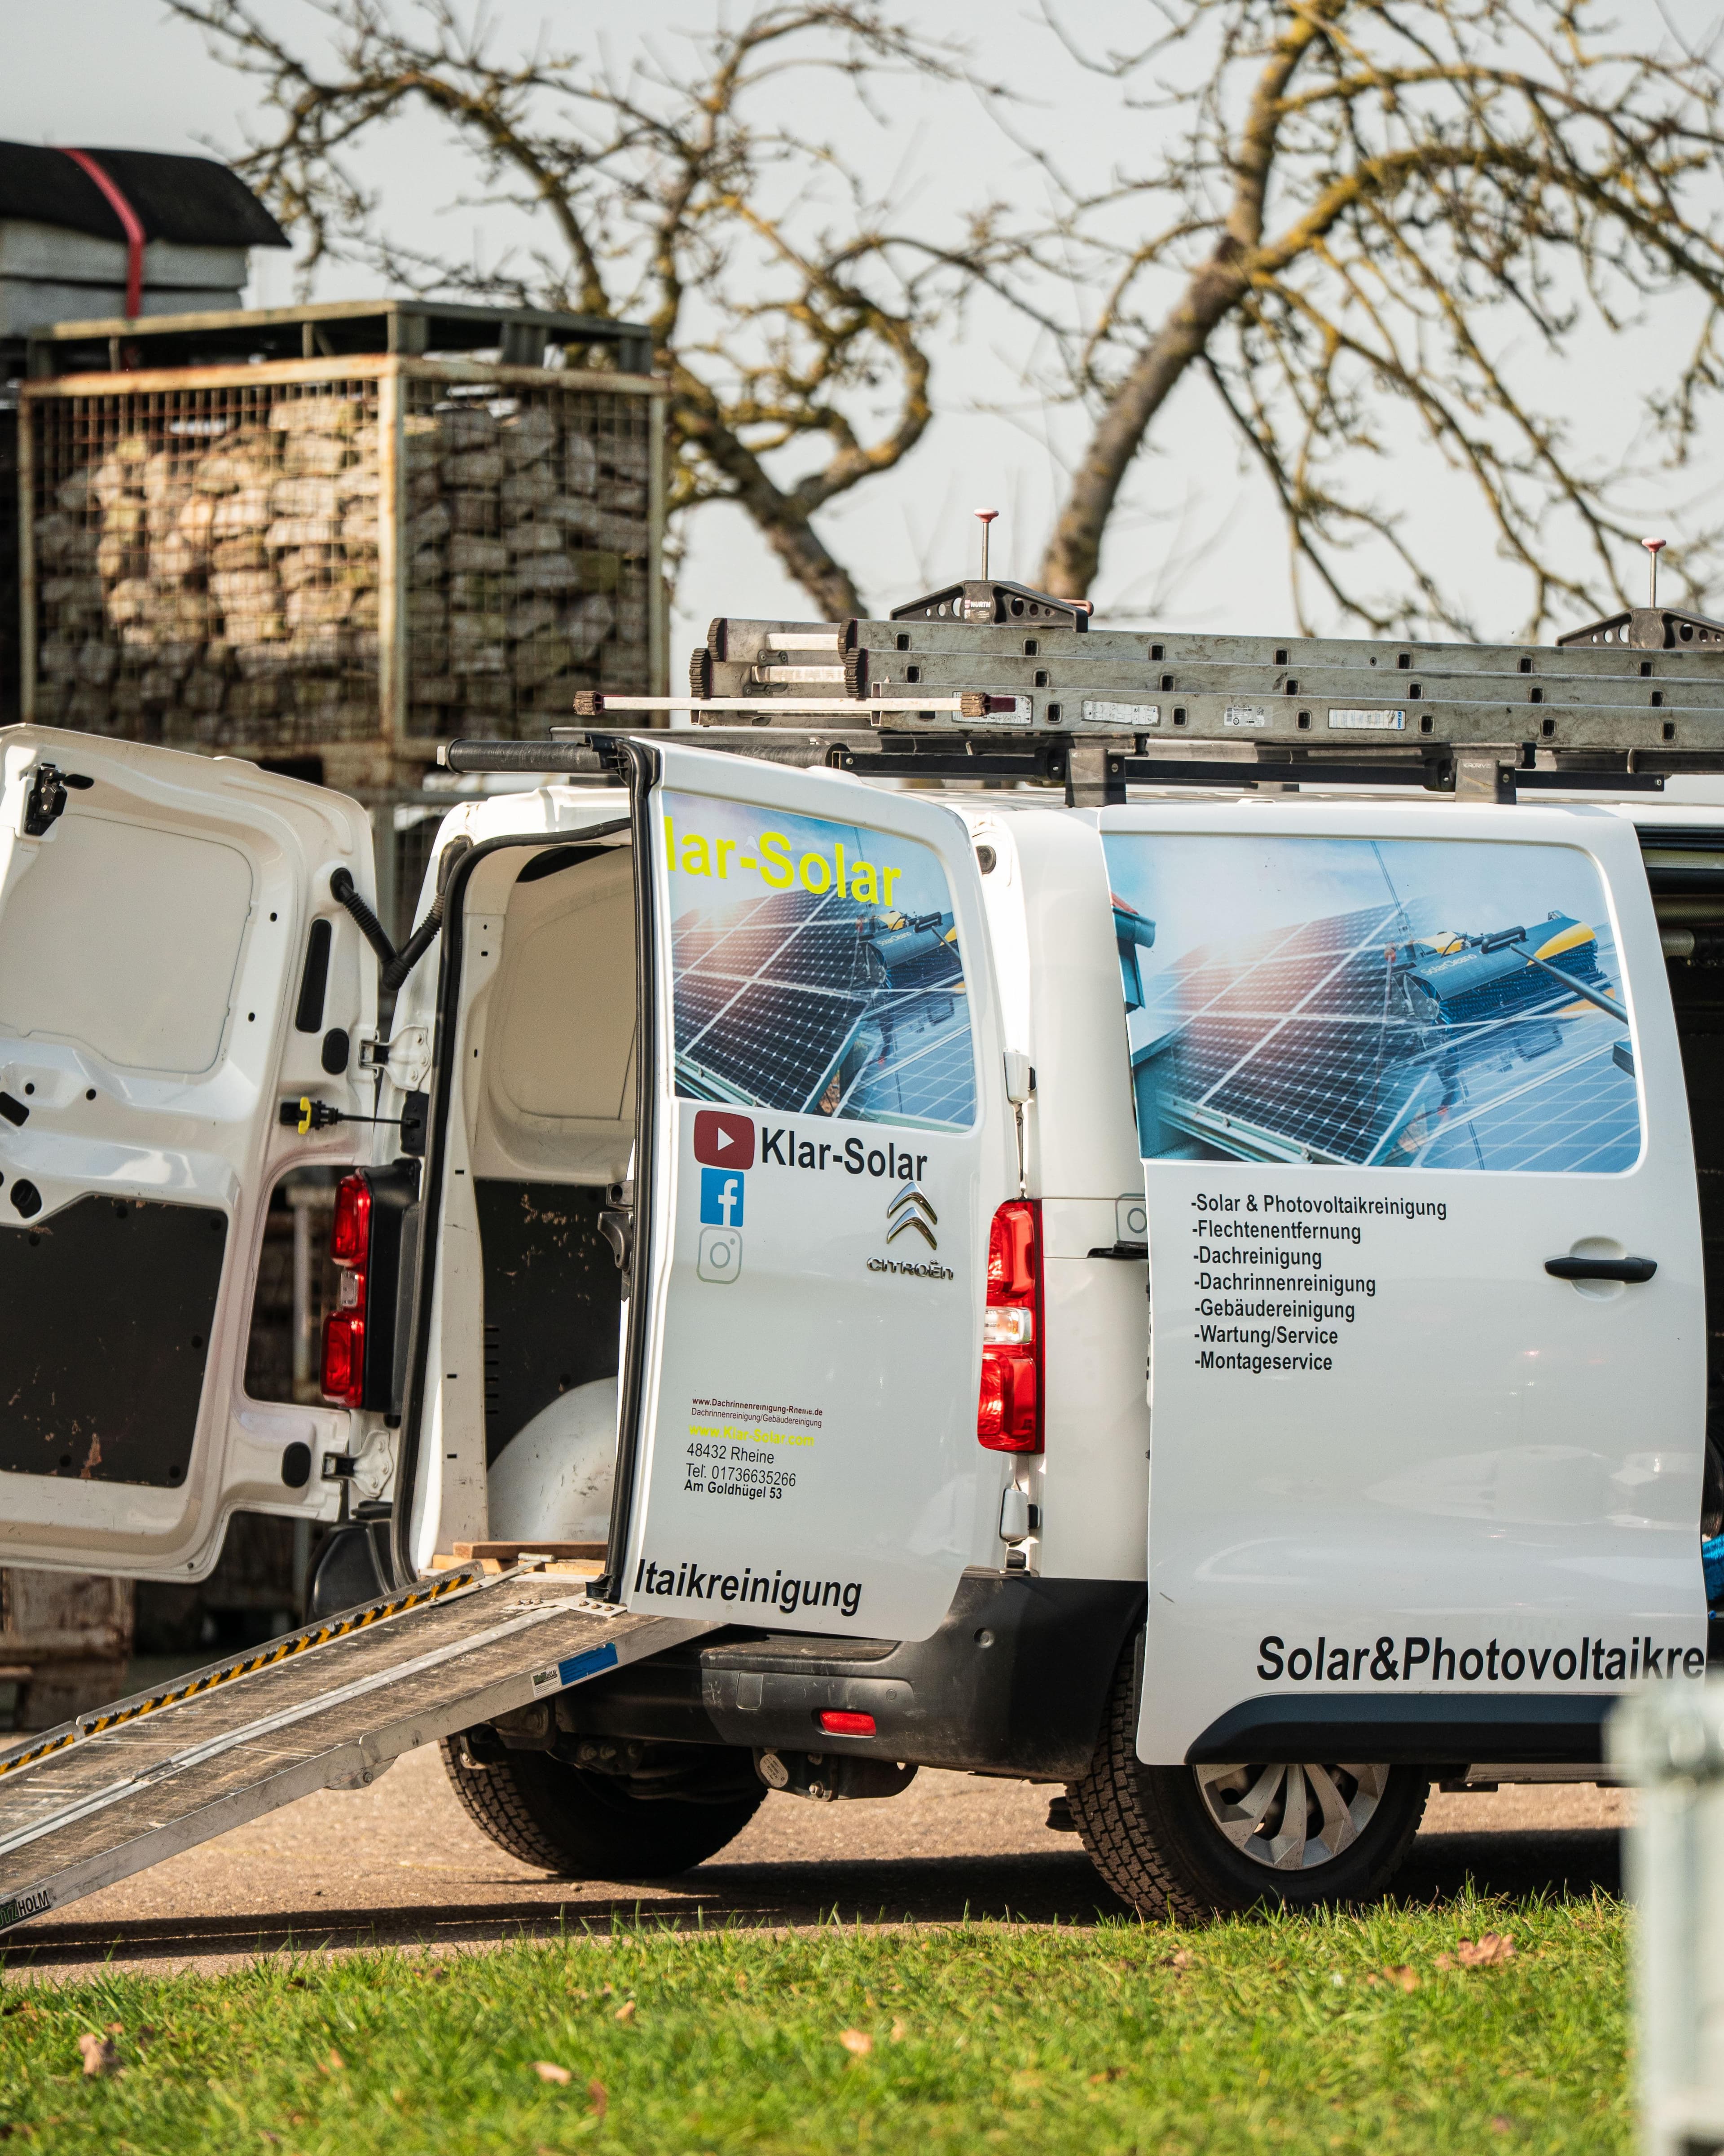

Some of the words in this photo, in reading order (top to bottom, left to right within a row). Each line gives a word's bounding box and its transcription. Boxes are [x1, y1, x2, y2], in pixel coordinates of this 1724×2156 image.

[762, 1127, 928, 1182] Klar-Solar
[1191, 1193, 1240, 1212] -Solar
[1246, 1194, 1258, 1212] &
[1263, 1195, 1447, 1221] Photovoltaikreinigung
[1192, 1220, 1361, 1244] -Flechtenentfernung
[1193, 1246, 1322, 1270] -Dachreinigung
[1194, 1272, 1376, 1297] -Dachrinnenreinigung
[1195, 1298, 1355, 1323] -Gebäudereinigung
[1194, 1325, 1338, 1348] -Wartung/Service
[1195, 1351, 1333, 1374] -Montageservice
[691, 1407, 822, 1429] Dachrinnenreinigung/Gebäudereinigung
[689, 1424, 814, 1446] www.Klar-Solar.com
[686, 1442, 726, 1459] 48432
[730, 1446, 774, 1464] Rheine
[712, 1465, 796, 1487] 01736635266
[684, 1479, 704, 1492] Am
[708, 1481, 766, 1500] Goldhügel
[769, 1487, 782, 1499] 53
[634, 1559, 862, 1617] ltaikreinigung
[1256, 1636, 1705, 1681] Solar&Photovoltaikre
